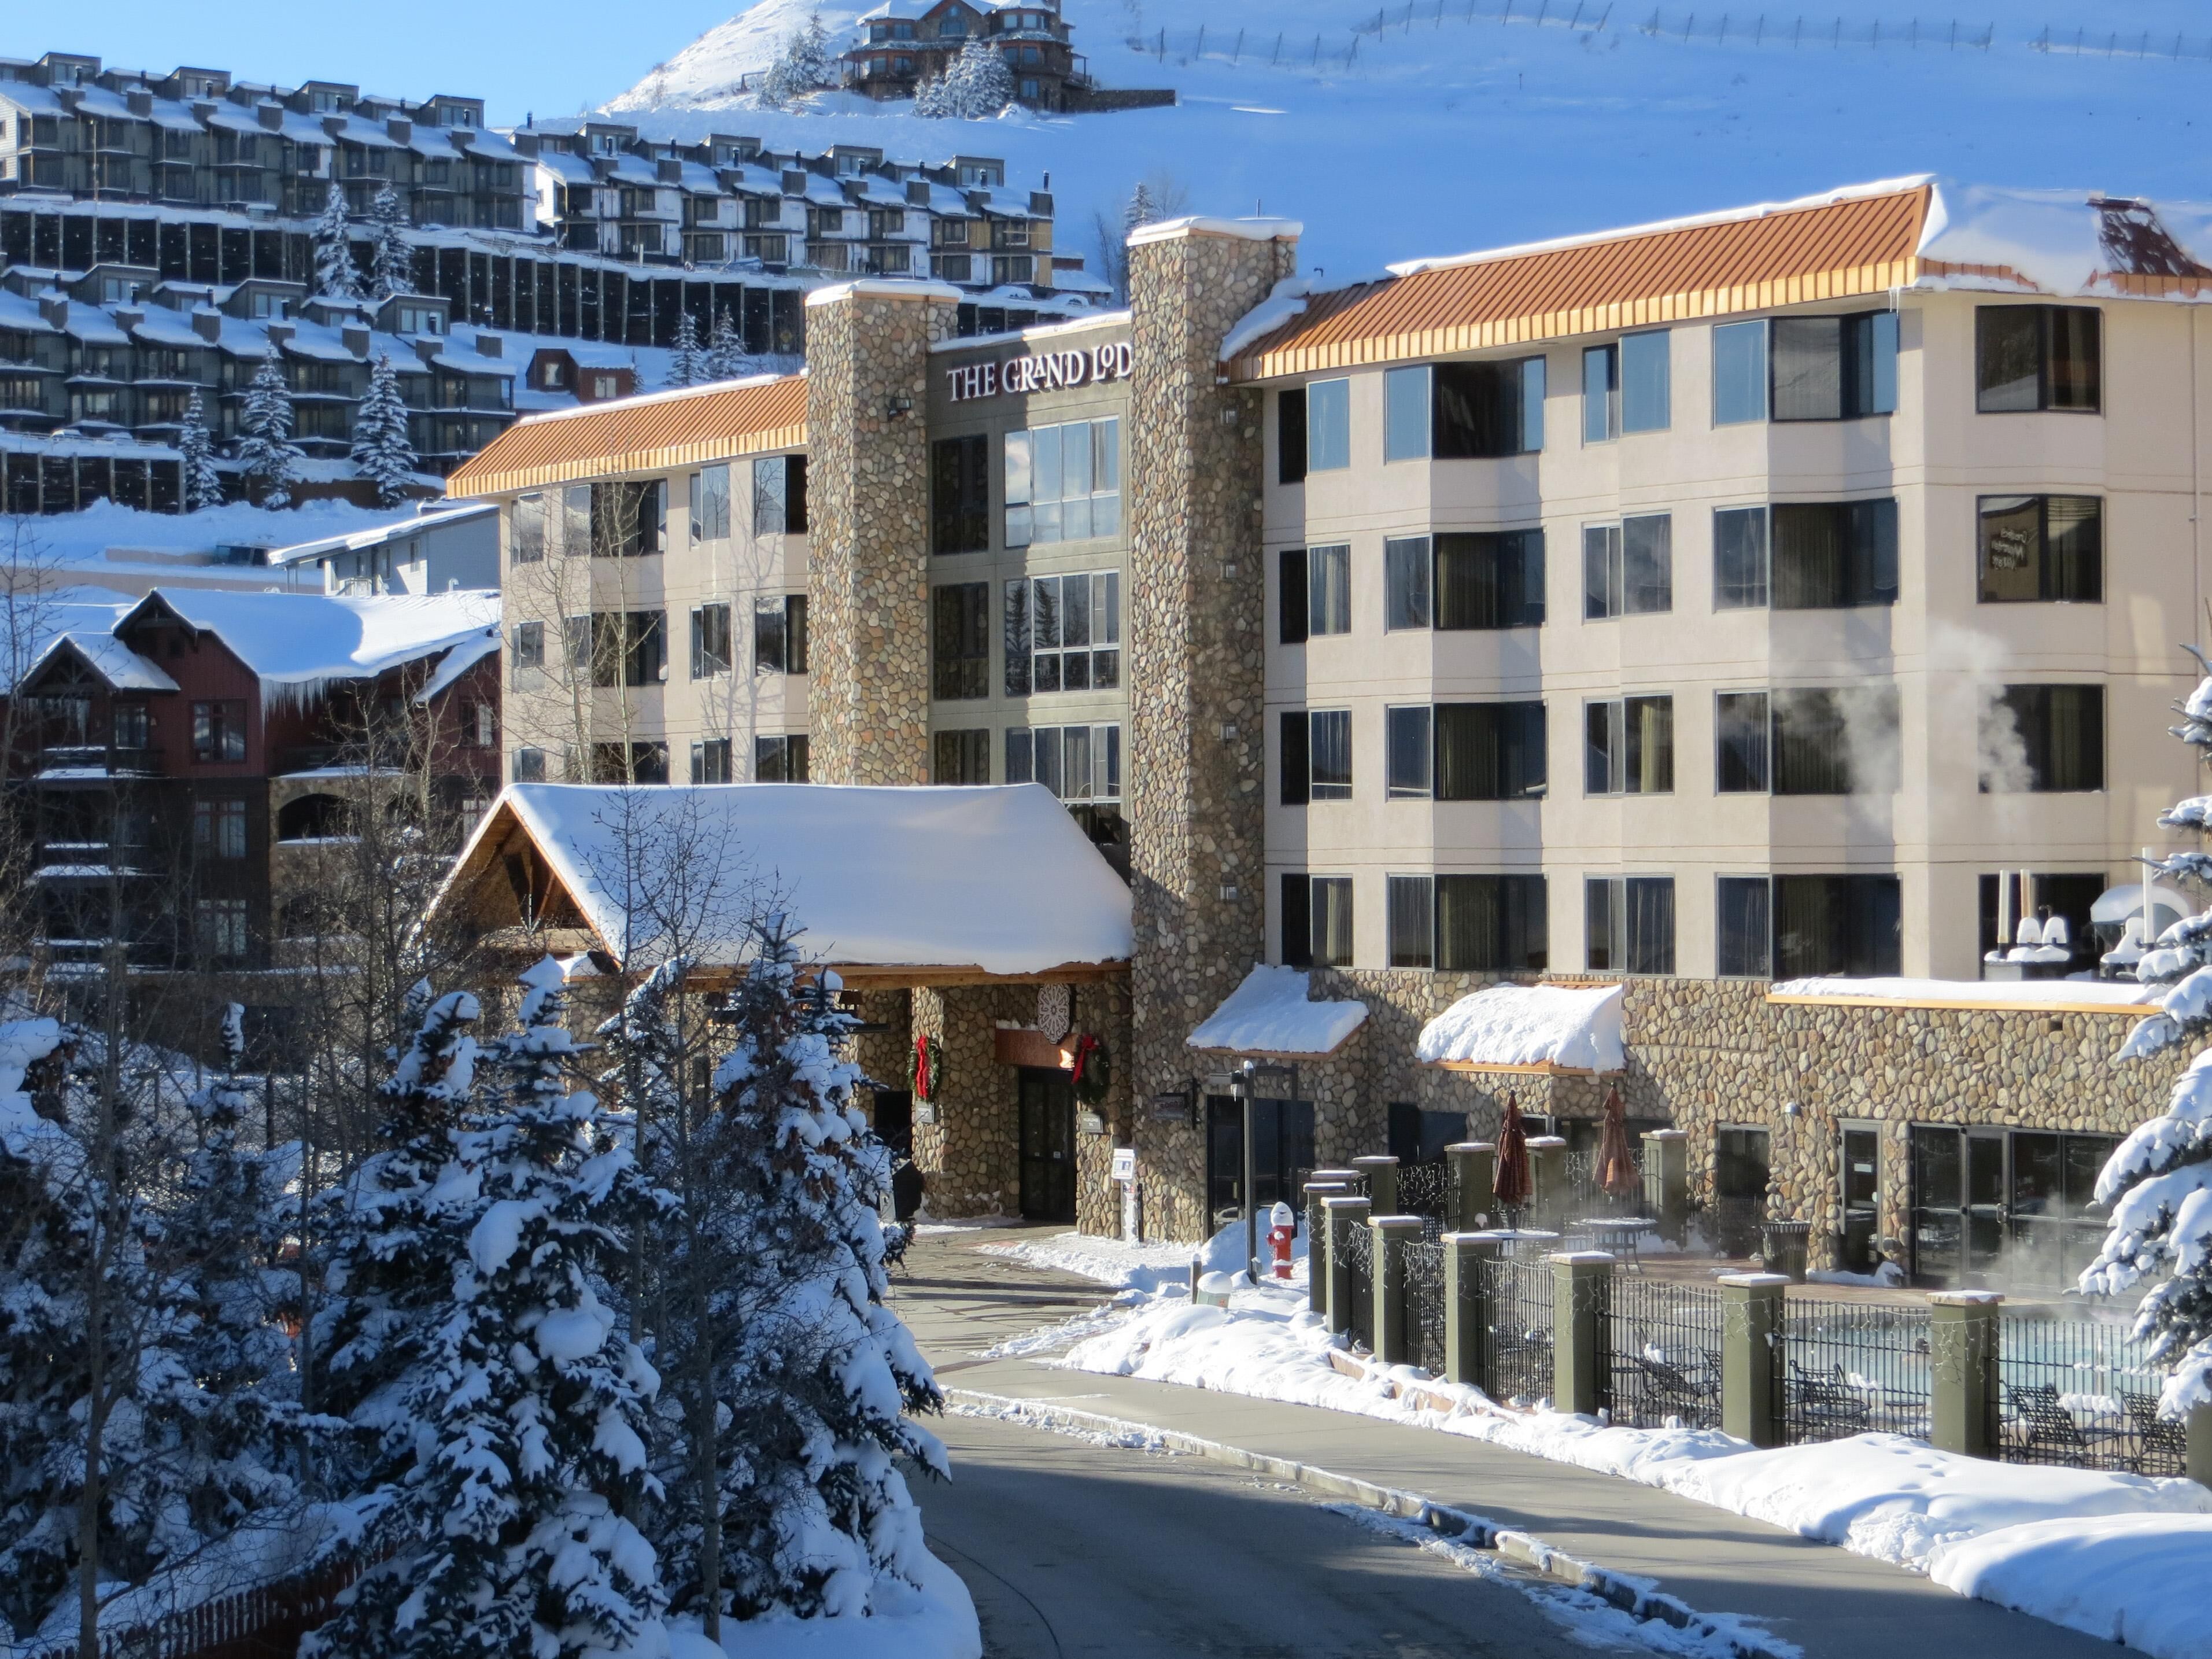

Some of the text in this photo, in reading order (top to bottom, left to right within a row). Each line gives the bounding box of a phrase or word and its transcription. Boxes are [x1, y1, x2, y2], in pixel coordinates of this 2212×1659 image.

[946, 341, 1133, 402] THE GRAND LOD
